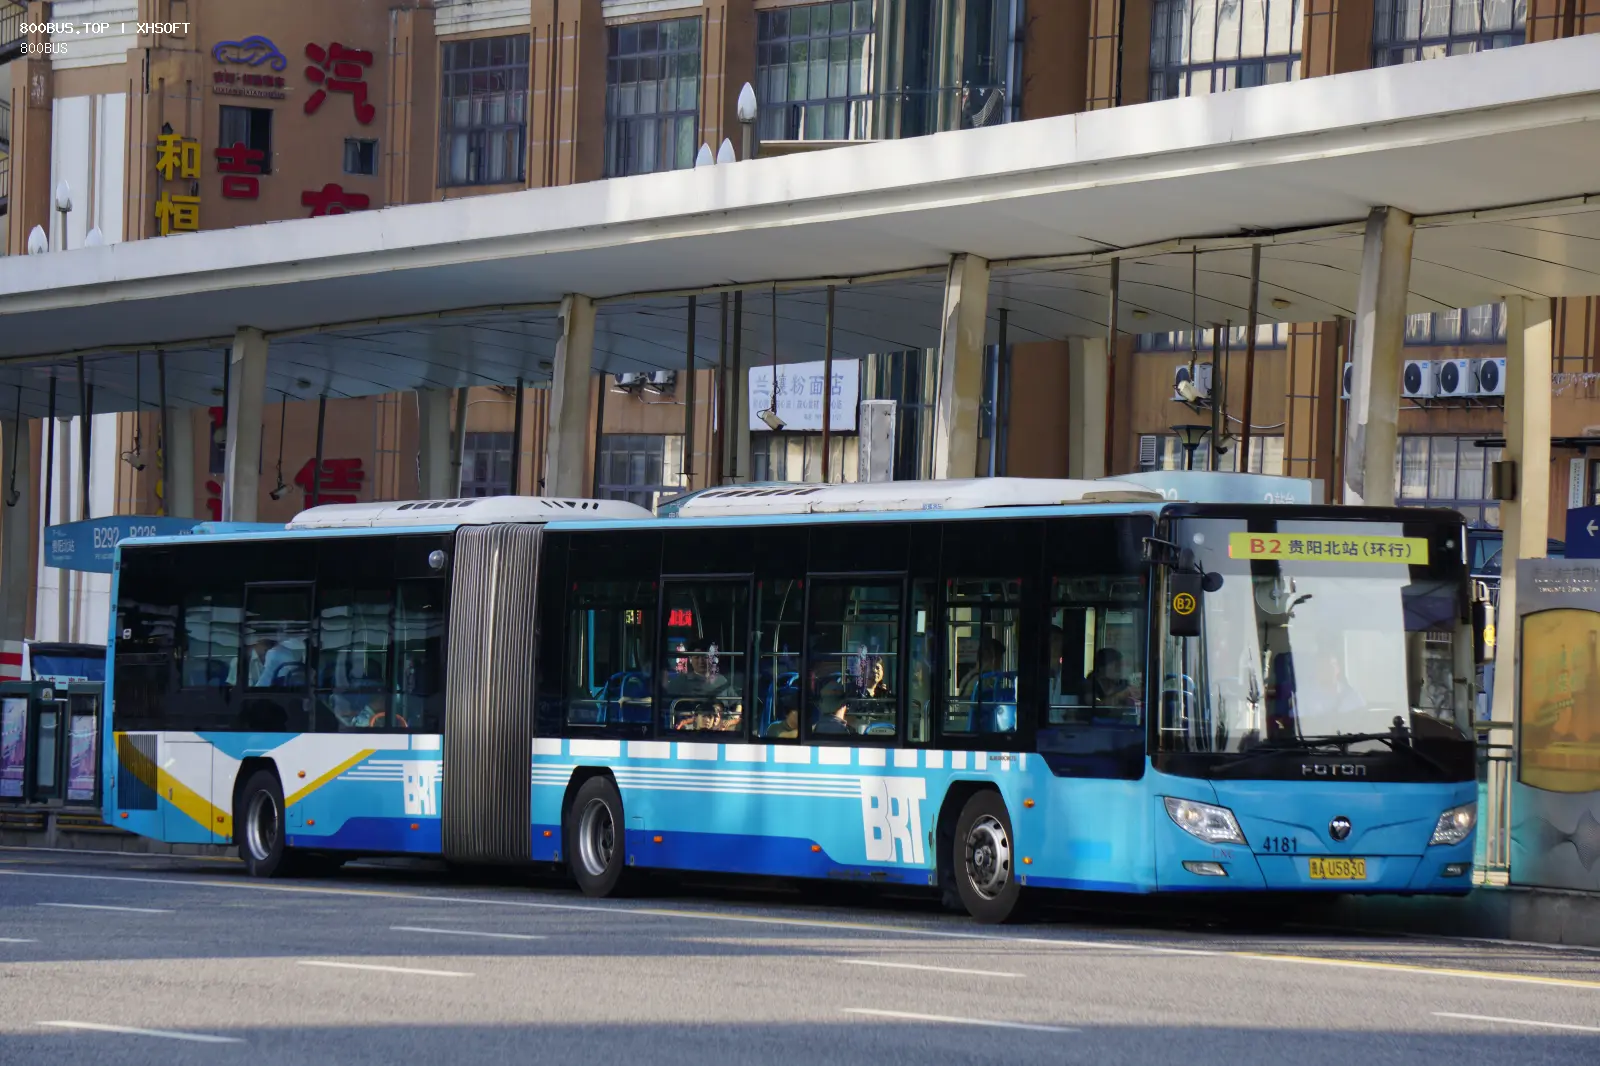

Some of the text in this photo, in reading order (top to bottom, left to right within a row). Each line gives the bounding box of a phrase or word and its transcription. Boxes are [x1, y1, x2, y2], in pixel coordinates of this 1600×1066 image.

[93, 526, 120, 549] B292
[1250, 538, 1412, 558] B2 贵阳北站(环行)
[1176, 597, 1192, 610] B2
[401, 760, 437, 816] BRT
[859, 776, 926, 864] BRT
[1262, 836, 1298, 853] 4181
